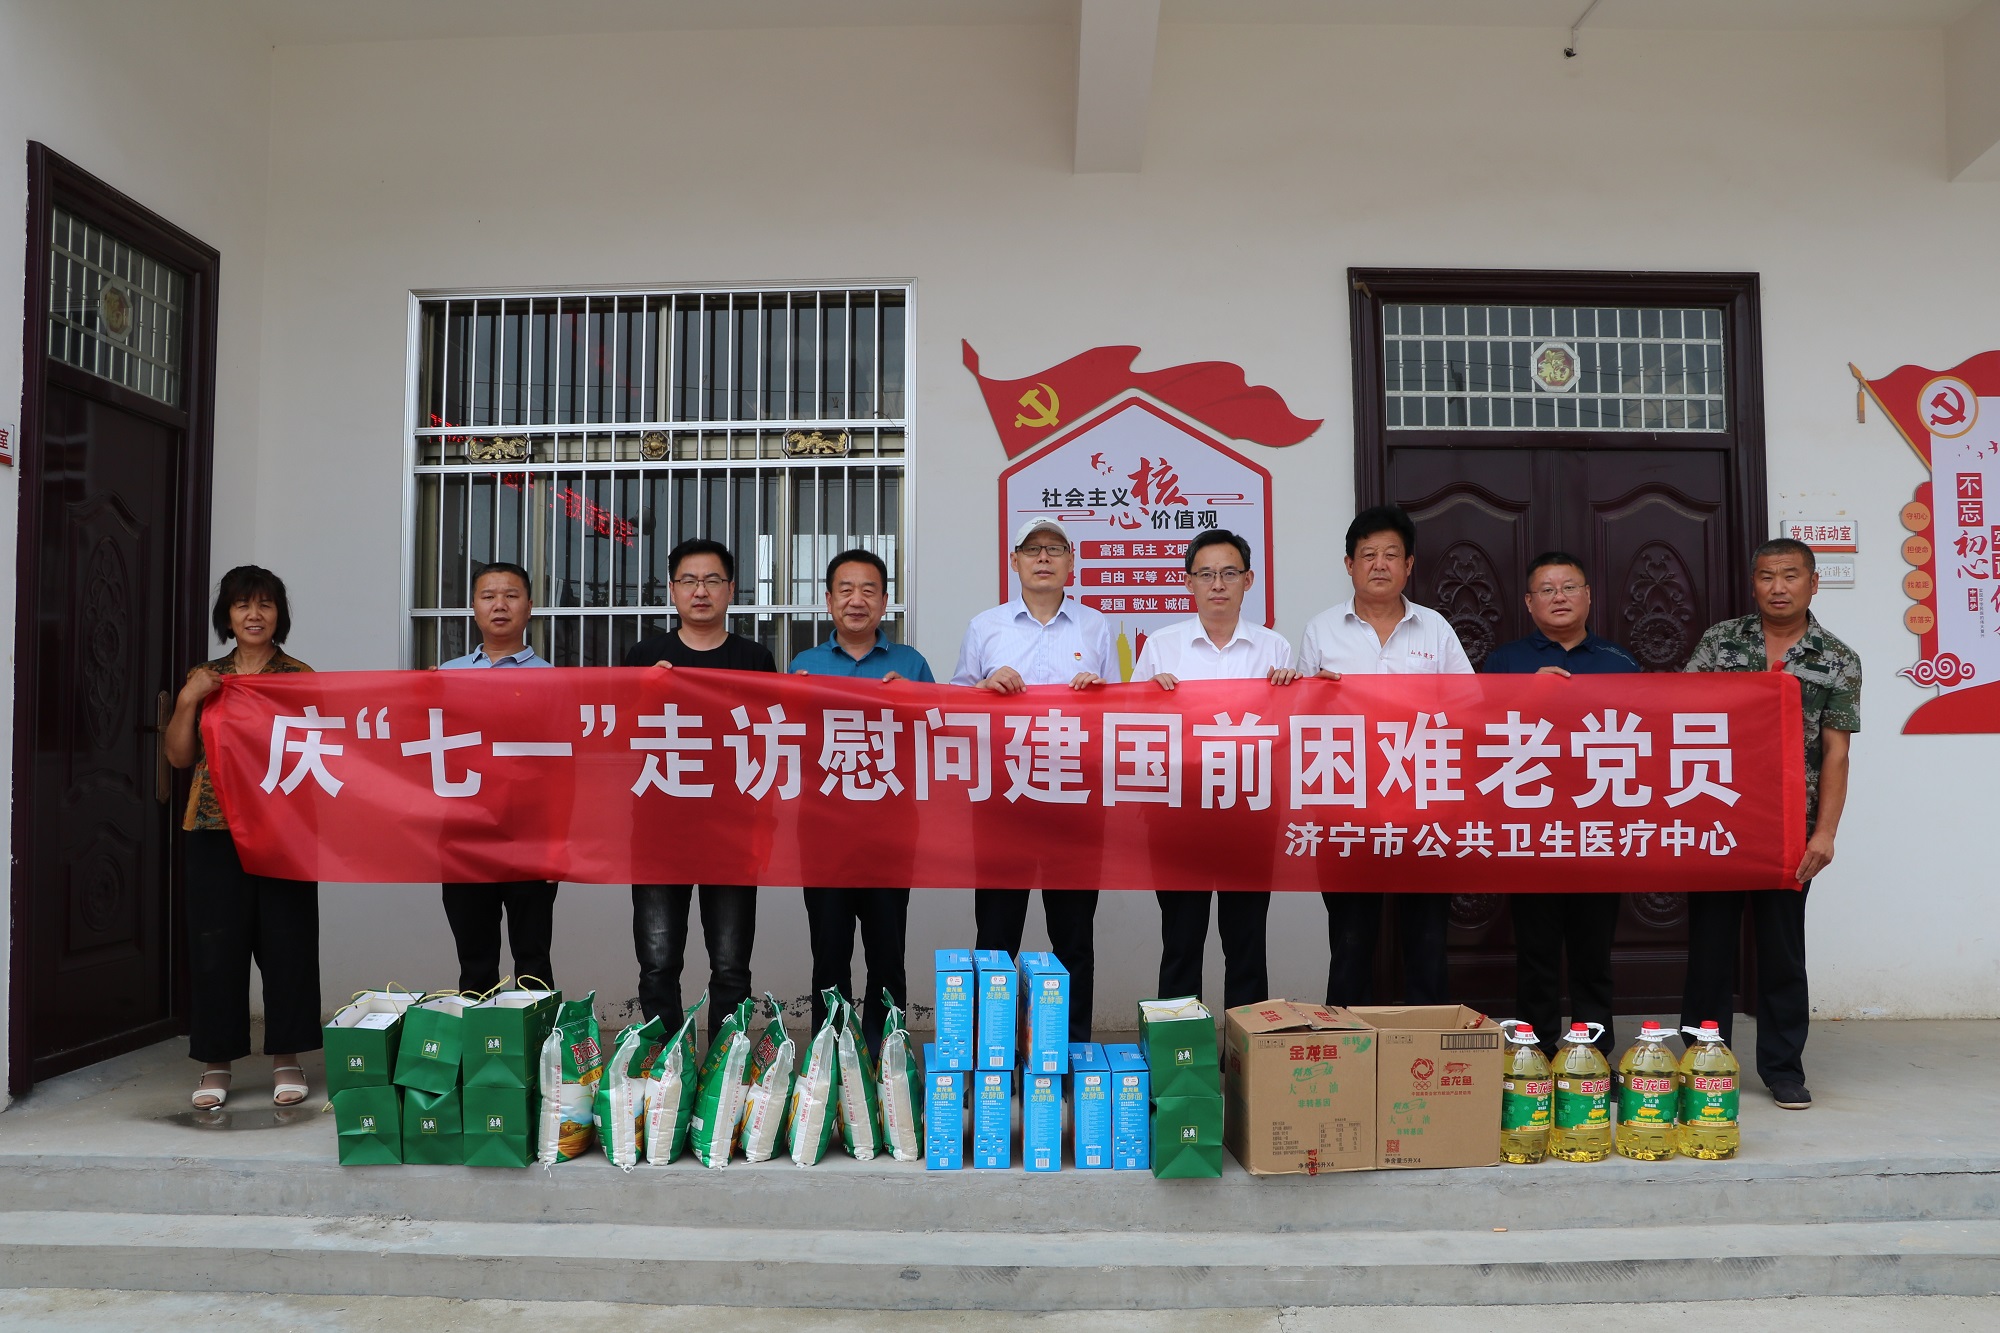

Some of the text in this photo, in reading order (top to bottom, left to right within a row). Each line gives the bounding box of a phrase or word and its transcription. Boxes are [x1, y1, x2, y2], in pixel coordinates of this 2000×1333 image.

[1906, 511, 1928, 521] 守初心
[1790, 525, 1852, 541] 党员活动室
[1100, 544, 1125, 556] 富强
[1132, 544, 1157, 556] 民主
[1907, 545, 1929, 555] 担使命
[1100, 571, 1125, 584] 自由
[1132, 571, 1158, 583] 平等
[1100, 597, 1190, 611] 爱国 敬业 诚信
[1284, 820, 1738, 859] 济宁市公共卫生医疗中心
[1441, 1076, 1473, 1086] 金龙鱼
[1632, 1078, 1671, 1092] 金龙鱼
[1695, 1077, 1733, 1090] 金龙鱼
